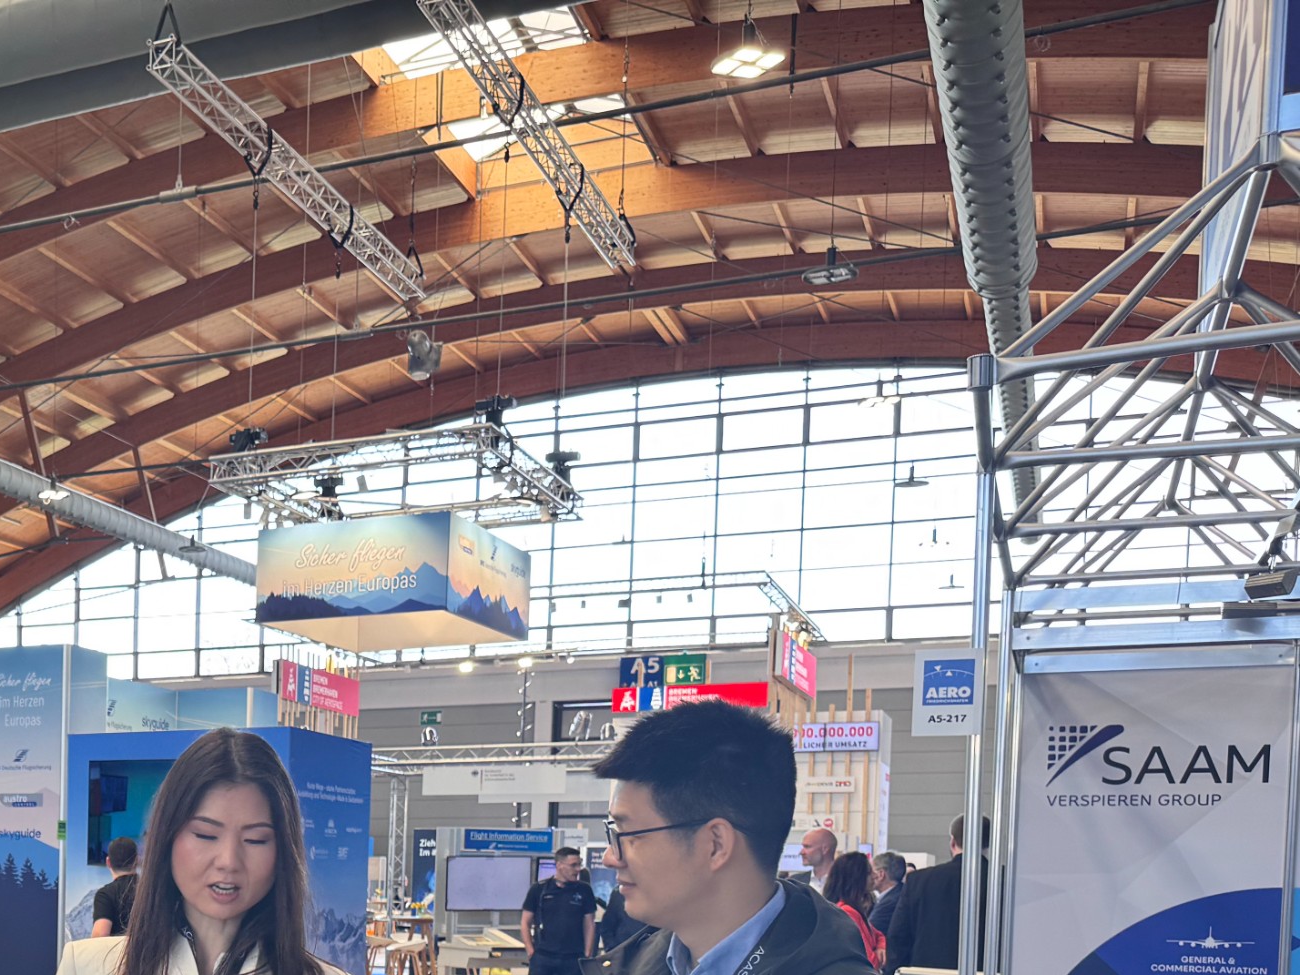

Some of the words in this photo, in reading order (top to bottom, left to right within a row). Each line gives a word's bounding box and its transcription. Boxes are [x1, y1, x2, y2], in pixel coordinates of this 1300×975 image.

[295, 543, 347, 568] Sicher
[348, 538, 406, 572] fliegen
[305, 577, 353, 596] Herzen
[358, 574, 418, 595] Europas
[925, 686, 971, 699] AERO
[13, 696, 45, 708] Herzen
[5, 714, 42, 728] Europas
[928, 714, 967, 723] A5-217
[835, 741, 868, 749] UMSATZ
[1101, 744, 1271, 786] SAAM
[1046, 794, 1152, 807] VERSPIEREN
[1158, 794, 1222, 807] GROUP
[470, 831, 488, 841] Flight
[488, 832, 525, 841] Information
[526, 833, 548, 842] Service
[1180, 955, 1226, 965] GENERAL
[1227, 957, 1236, 965] &
[1150, 964, 1217, 974] COMMERCIAL
[1219, 966, 1268, 975] AVIATION
